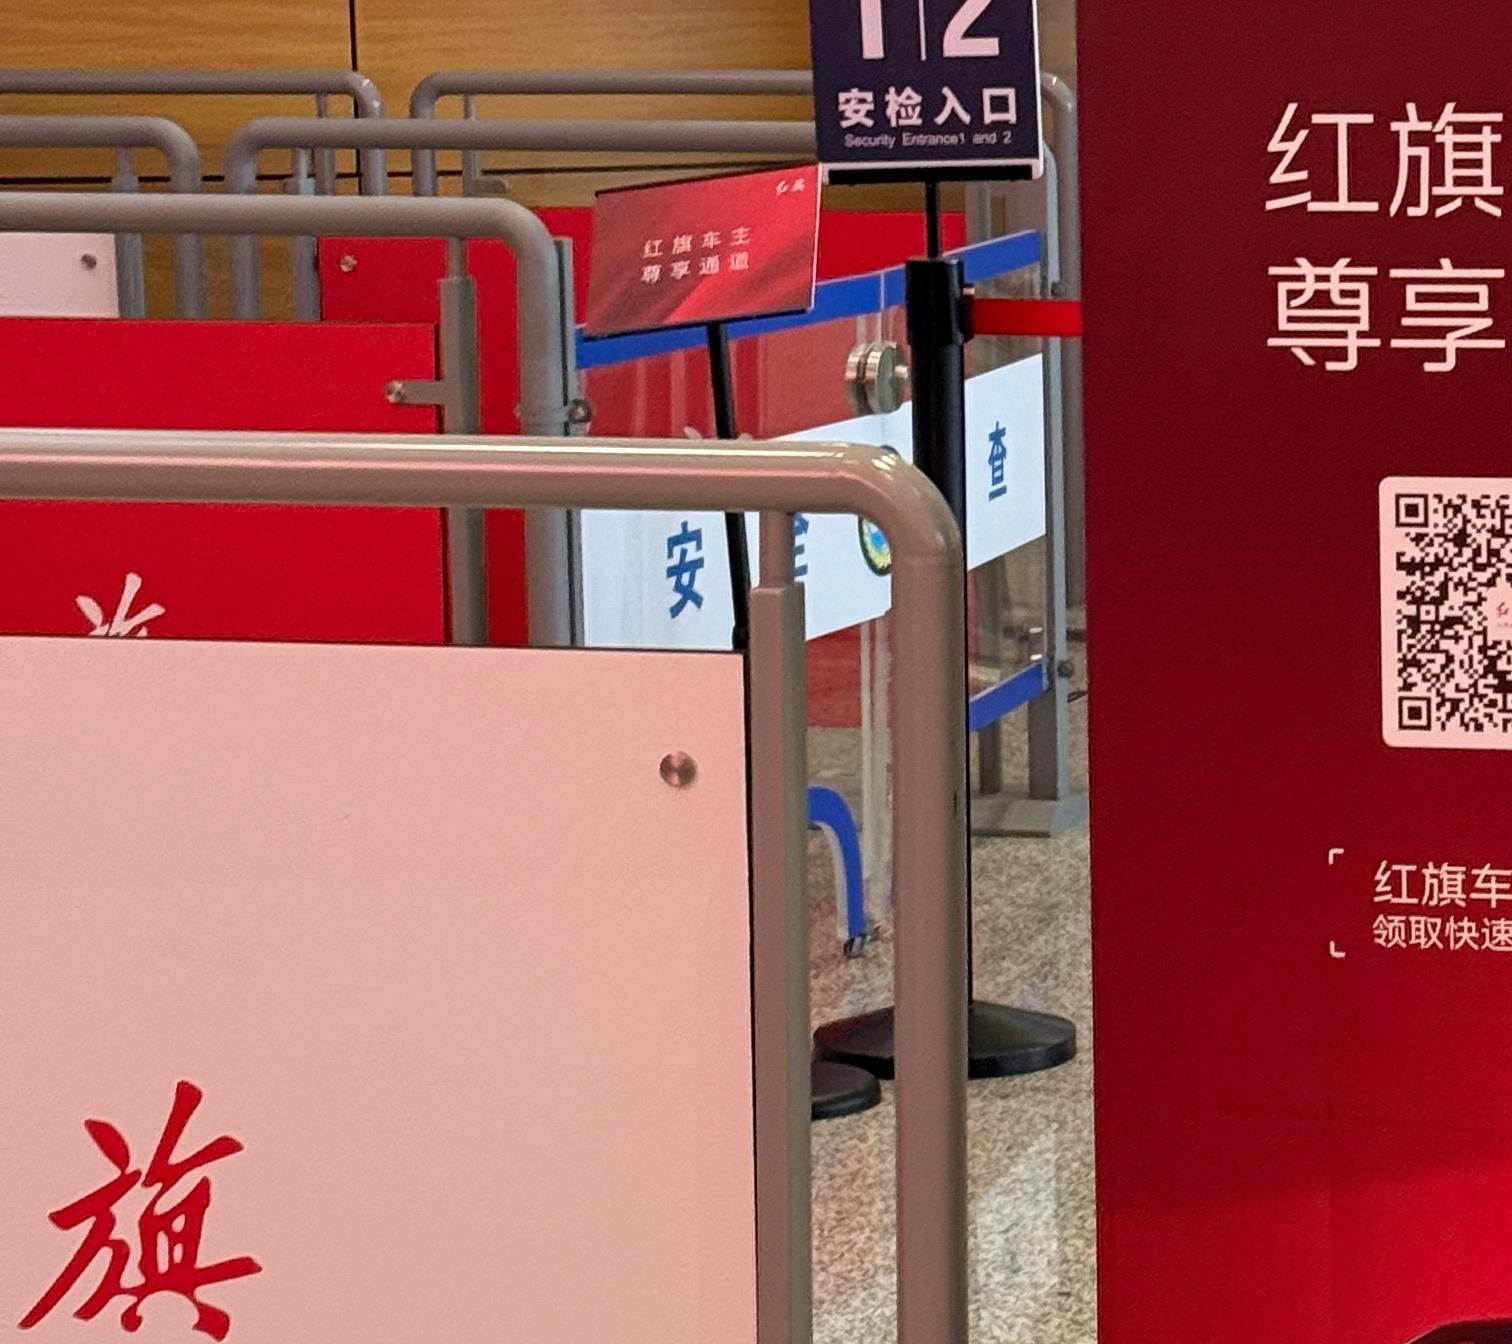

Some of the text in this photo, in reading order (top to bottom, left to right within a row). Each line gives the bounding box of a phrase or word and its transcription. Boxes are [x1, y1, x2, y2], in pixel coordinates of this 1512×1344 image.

[837, 86, 1017, 129] 安检入口
[844, 132, 895, 149] Security
[973, 130, 996, 145] and
[1003, 130, 1012, 145] 2
[642, 226, 751, 259] 红旗车主
[640, 252, 750, 285] 尊享通道
[16, 1078, 264, 1343] 旗
